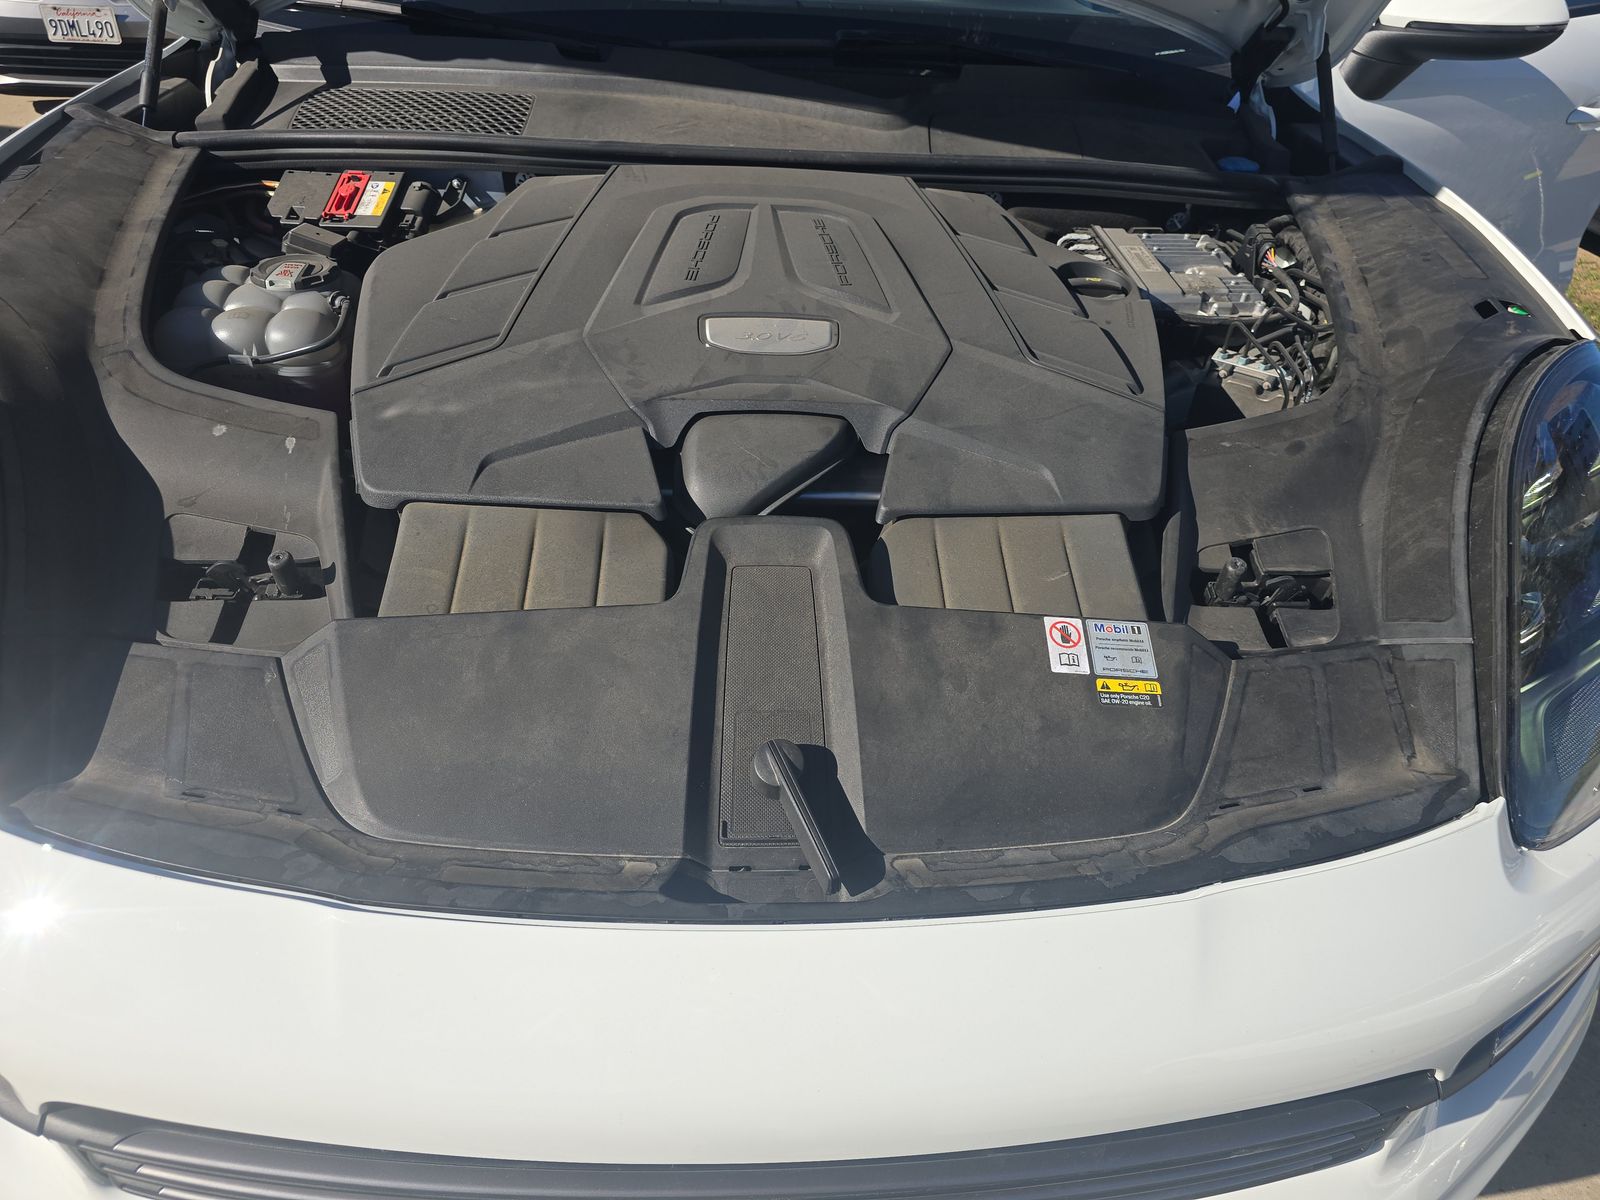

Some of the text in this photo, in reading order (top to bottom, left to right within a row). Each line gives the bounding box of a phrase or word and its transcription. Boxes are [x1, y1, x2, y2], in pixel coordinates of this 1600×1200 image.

[56, 8, 97, 19] California
[48, 19, 115, 38] 9DML490
[684, 214, 721, 281] PORSCHE
[812, 216, 853, 287] PORSCHE
[1094, 623, 1142, 635] Mobil 1
